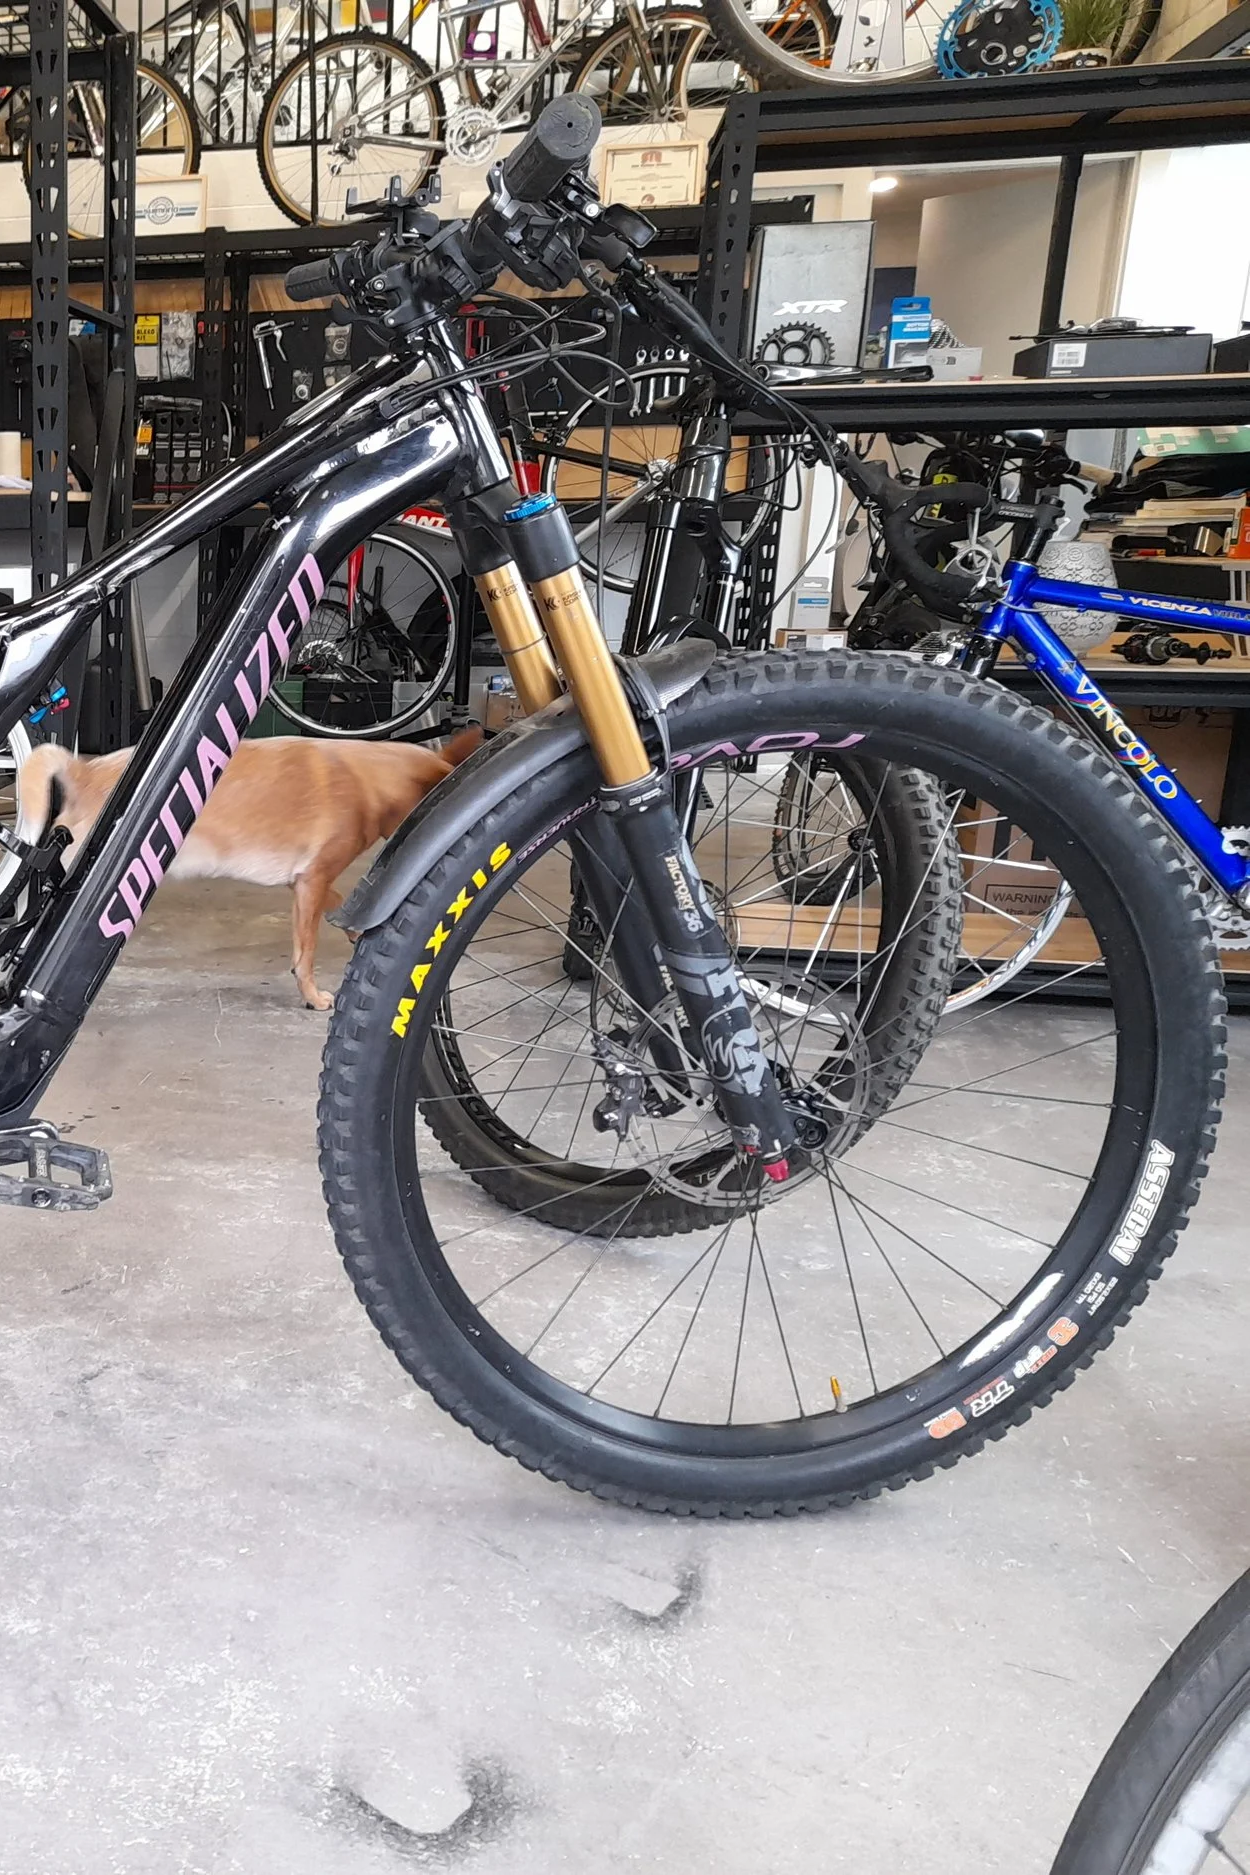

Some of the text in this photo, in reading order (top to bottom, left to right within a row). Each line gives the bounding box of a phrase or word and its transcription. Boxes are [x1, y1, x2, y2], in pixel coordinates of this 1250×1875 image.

[773, 299, 849, 316] XTR
[1128, 596, 1213, 617] VICENZA
[98, 552, 325, 941] SPECIALIZED
[1076, 673, 1178, 799] VINCOLO
[665, 856, 696, 911] FACTORY
[683, 910, 704, 932] 36
[391, 842, 512, 1038] MAXXIS
[659, 965, 690, 1029] FACRY
[1108, 1138, 1176, 1267] ASSEGAI
[971, 1380, 1015, 1418] TR
